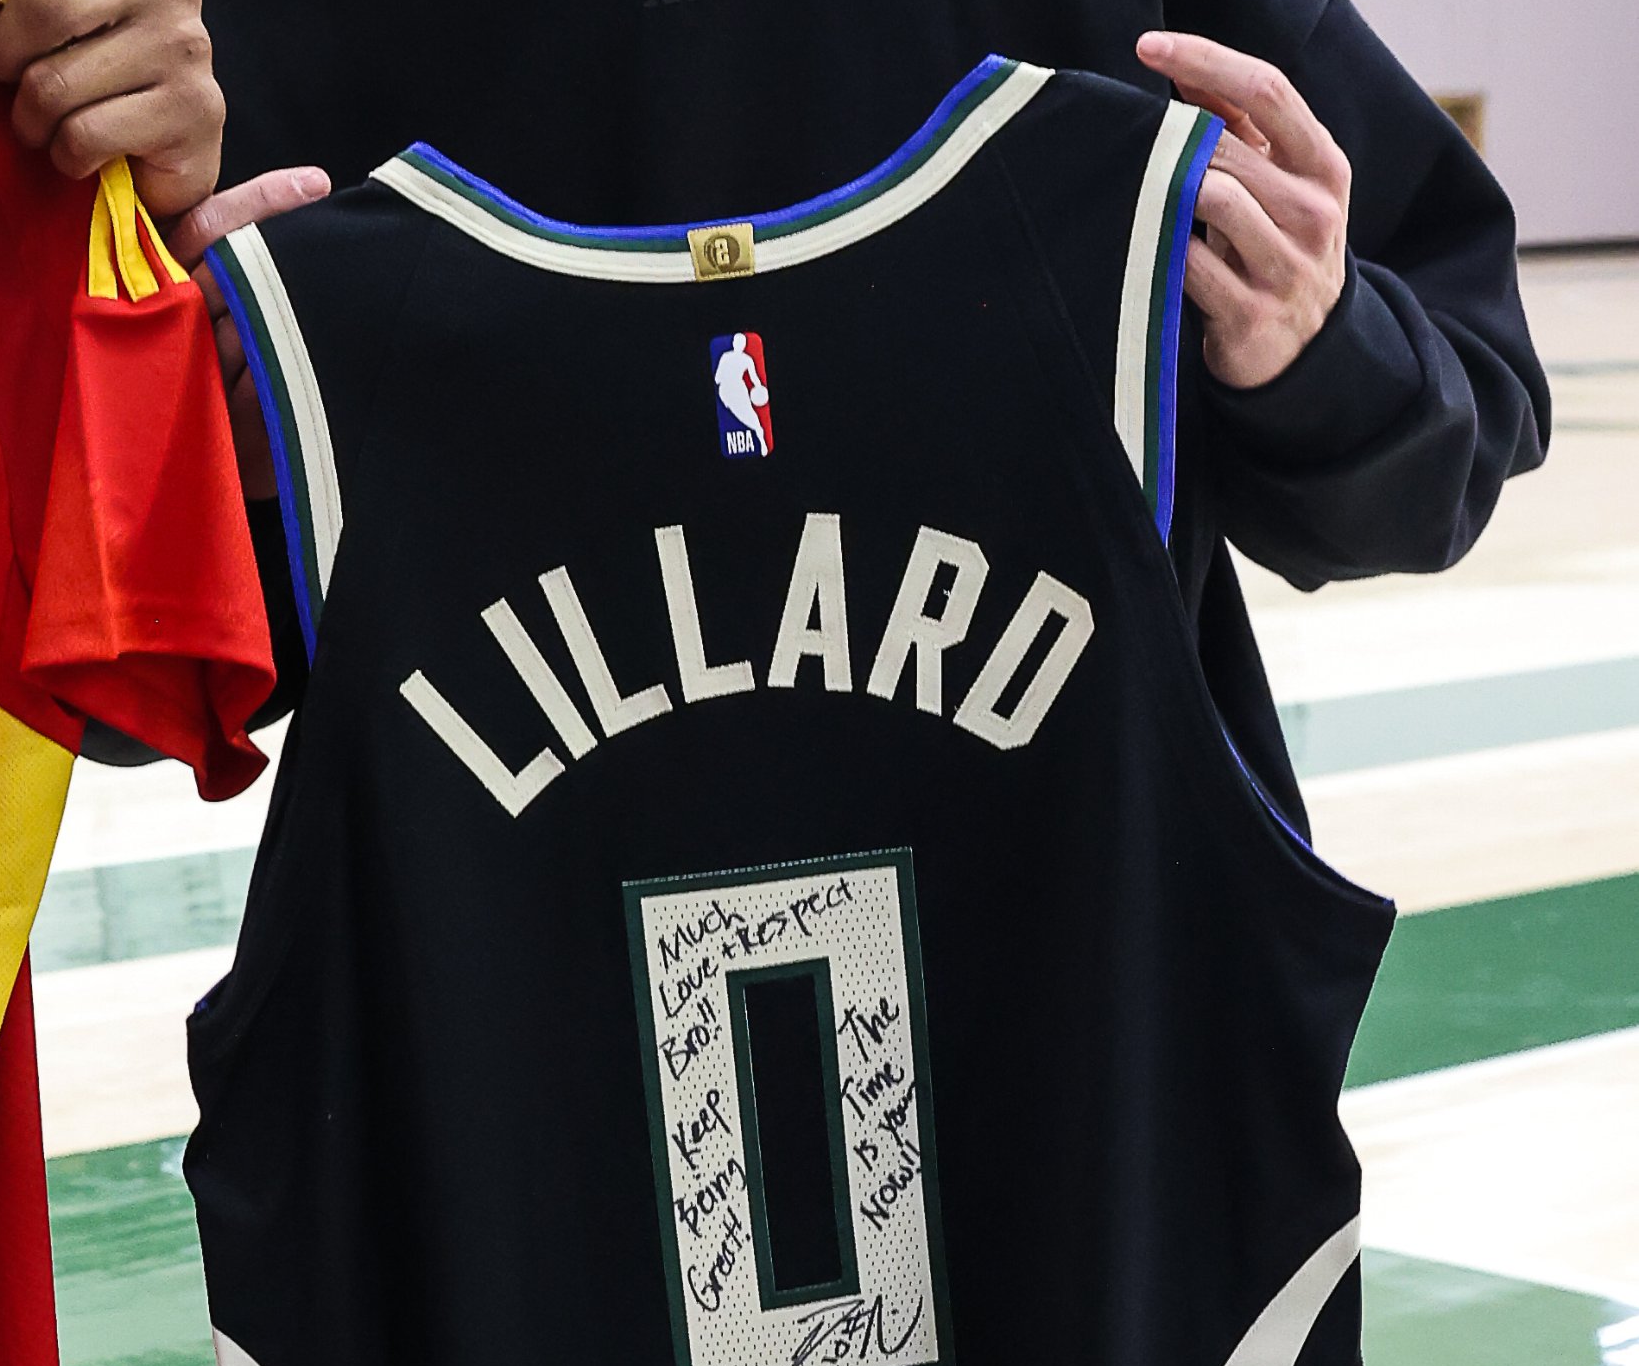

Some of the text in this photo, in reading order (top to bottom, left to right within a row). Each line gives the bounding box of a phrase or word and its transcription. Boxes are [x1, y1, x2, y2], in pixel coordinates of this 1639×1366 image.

[726, 430, 755, 455] NBA
[399, 512, 1095, 818] LILLARD
[658, 901, 746, 970] Much
[659, 956, 719, 1018] Love
[838, 997, 900, 1063] The
[841, 1062, 905, 1121] Time
[671, 1089, 732, 1170] Keep
